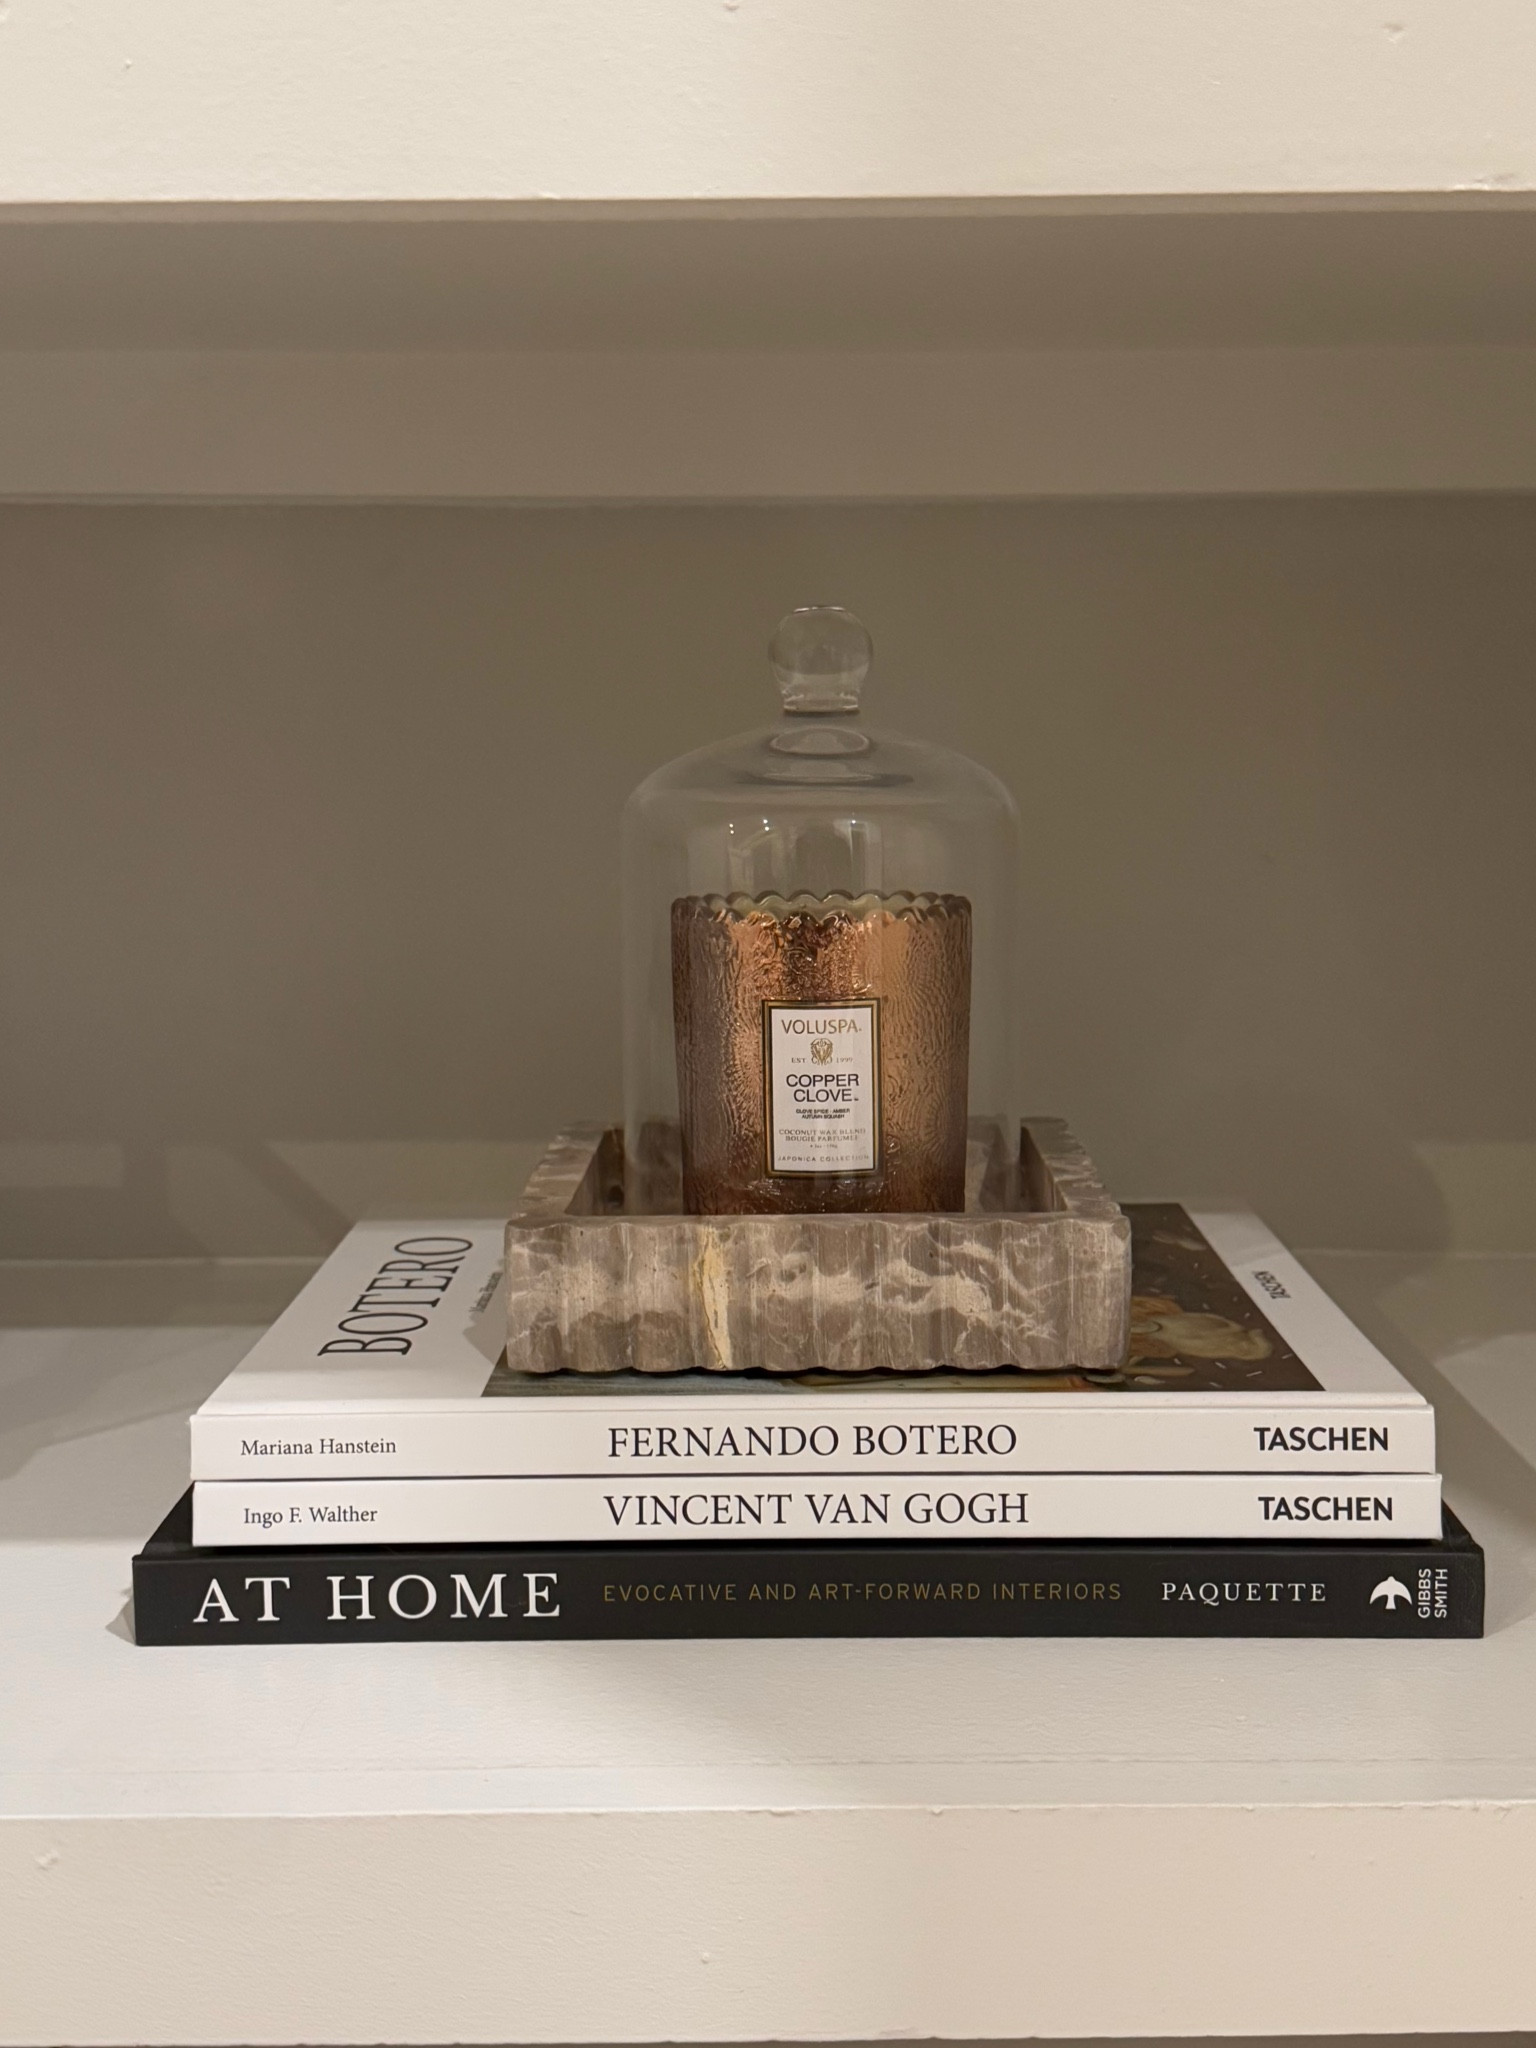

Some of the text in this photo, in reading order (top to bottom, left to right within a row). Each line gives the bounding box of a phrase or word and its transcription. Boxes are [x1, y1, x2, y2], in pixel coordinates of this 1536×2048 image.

[786, 1074, 859, 1087] COPPER
[317, 1237, 473, 1356] BOTERO
[240, 1437, 397, 1455] Mariana Hanstein
[608, 1424, 1016, 1457] FERNANDO BOTERO
[1254, 1427, 1388, 1452] TASCHEN
[243, 1505, 378, 1529] Ingo F. Walther
[603, 1492, 1030, 1526] VINCENT VAN GOGH
[1258, 1496, 1393, 1521] TASCHEN
[192, 1572, 560, 1623] AT HOME
[603, 1583, 1122, 1602] EVOCATIVE AND ART-FORWARD INTERIORS
[1161, 1582, 1327, 1607] PAQUETTE
[1417, 1568, 1432, 1619] GIBBS
[1434, 1568, 1448, 1619] SMITH
